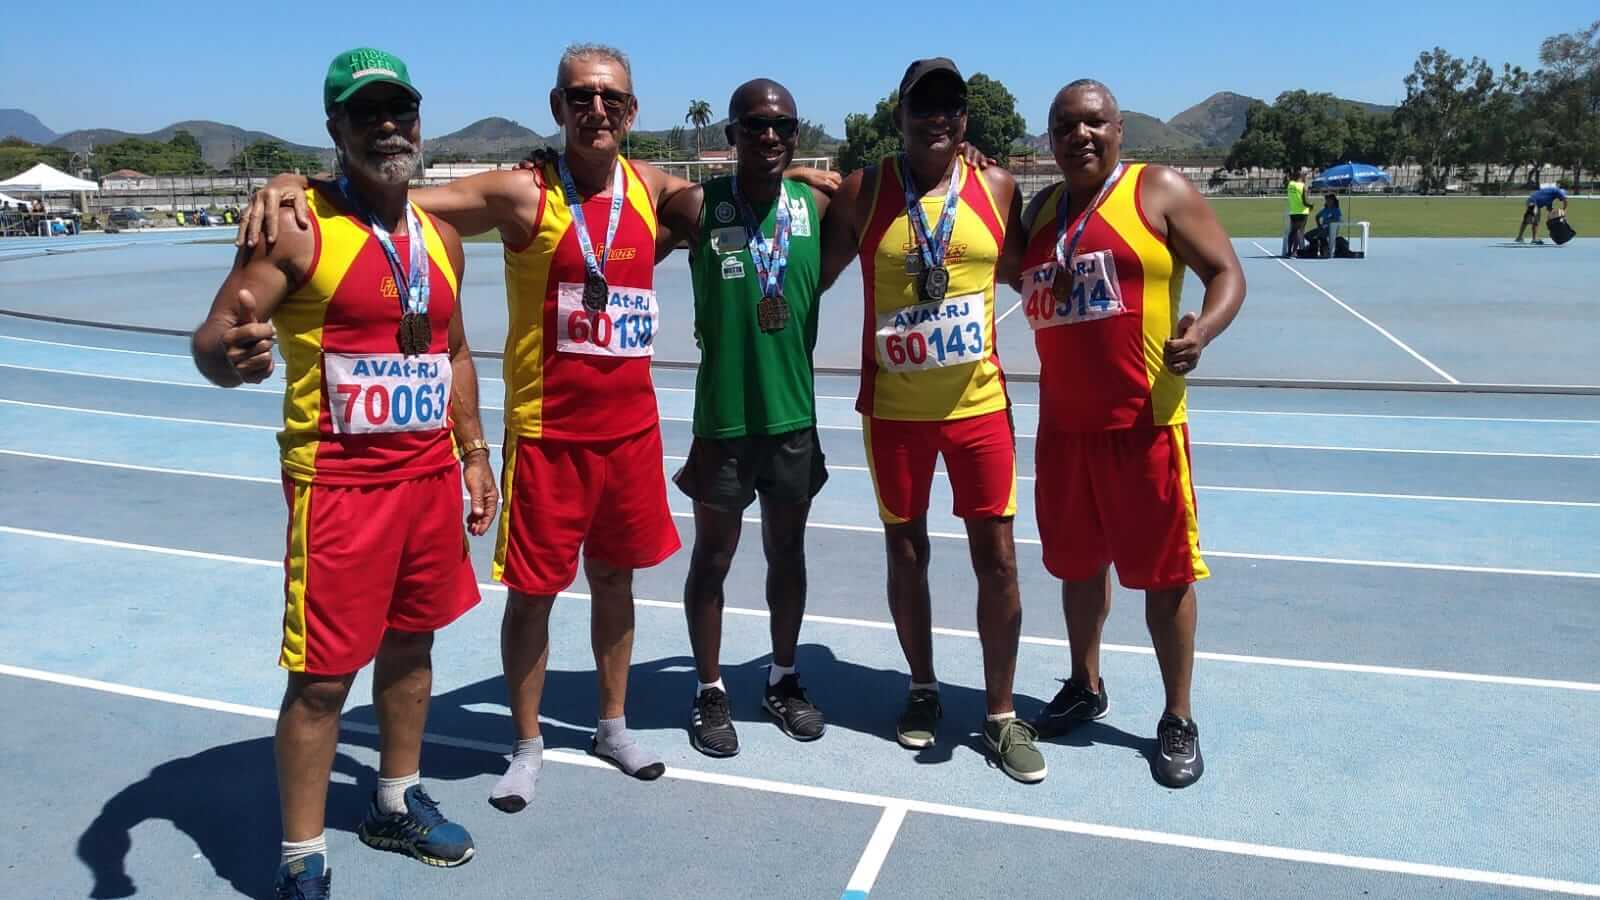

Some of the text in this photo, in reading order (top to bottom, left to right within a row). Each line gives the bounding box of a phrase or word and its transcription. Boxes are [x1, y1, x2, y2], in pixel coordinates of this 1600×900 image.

[1033, 260, 1096, 284] AV-RJ
[609, 292, 650, 311] At-RJ
[894, 302, 969, 329] AVAt-RJ
[568, 310, 652, 349] 60138
[886, 321, 982, 366] 60143
[352, 359, 439, 378] AVAt-RJ
[336, 382, 445, 426] 70063
